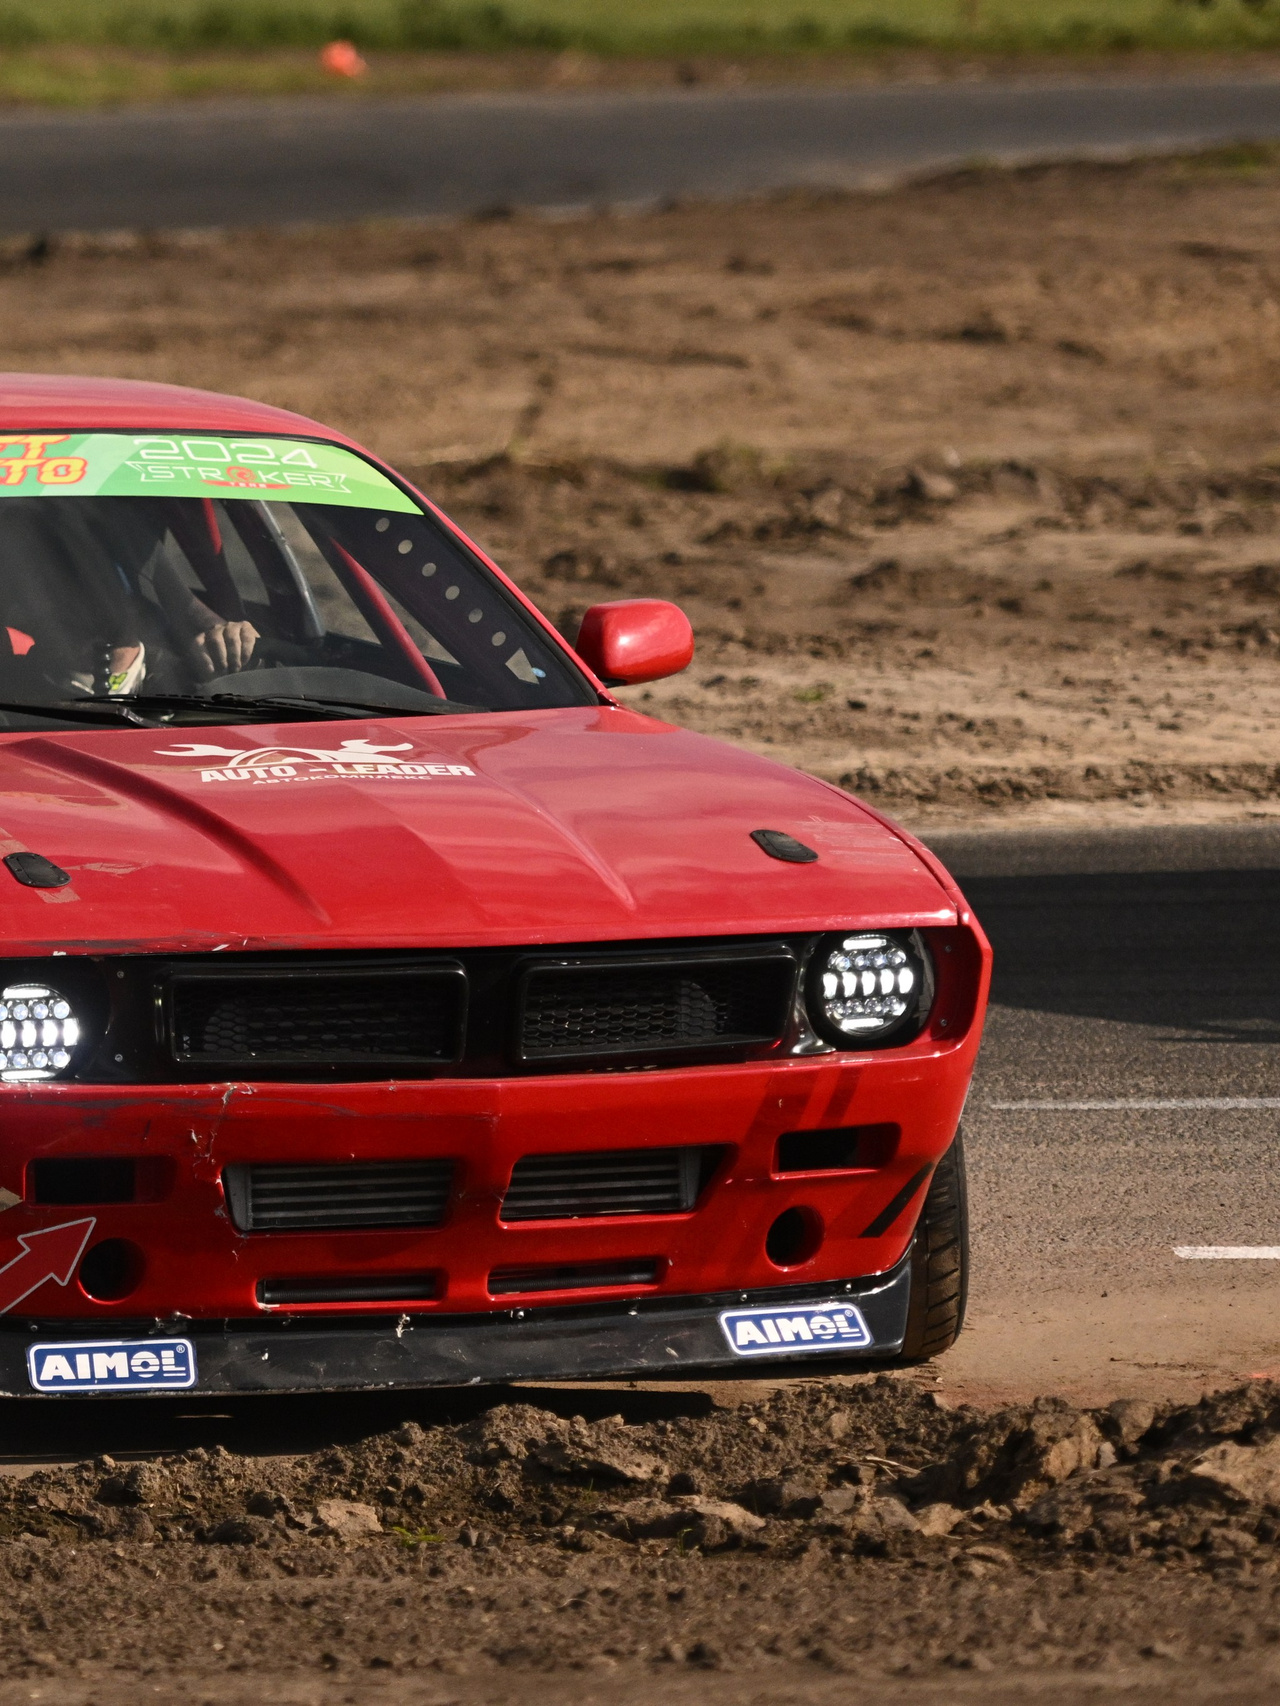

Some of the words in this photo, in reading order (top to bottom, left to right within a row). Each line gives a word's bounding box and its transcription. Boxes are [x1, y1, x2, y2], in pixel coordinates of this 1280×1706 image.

[133, 438, 318, 469] 2024
[201, 764, 297, 783] AUTO
[331, 763, 477, 777] LEADER
[252, 773, 433, 786] АВТОКОМПЛЕКС
[736, 1314, 862, 1346] AIMOL
[39, 1350, 187, 1381] AIMOL
